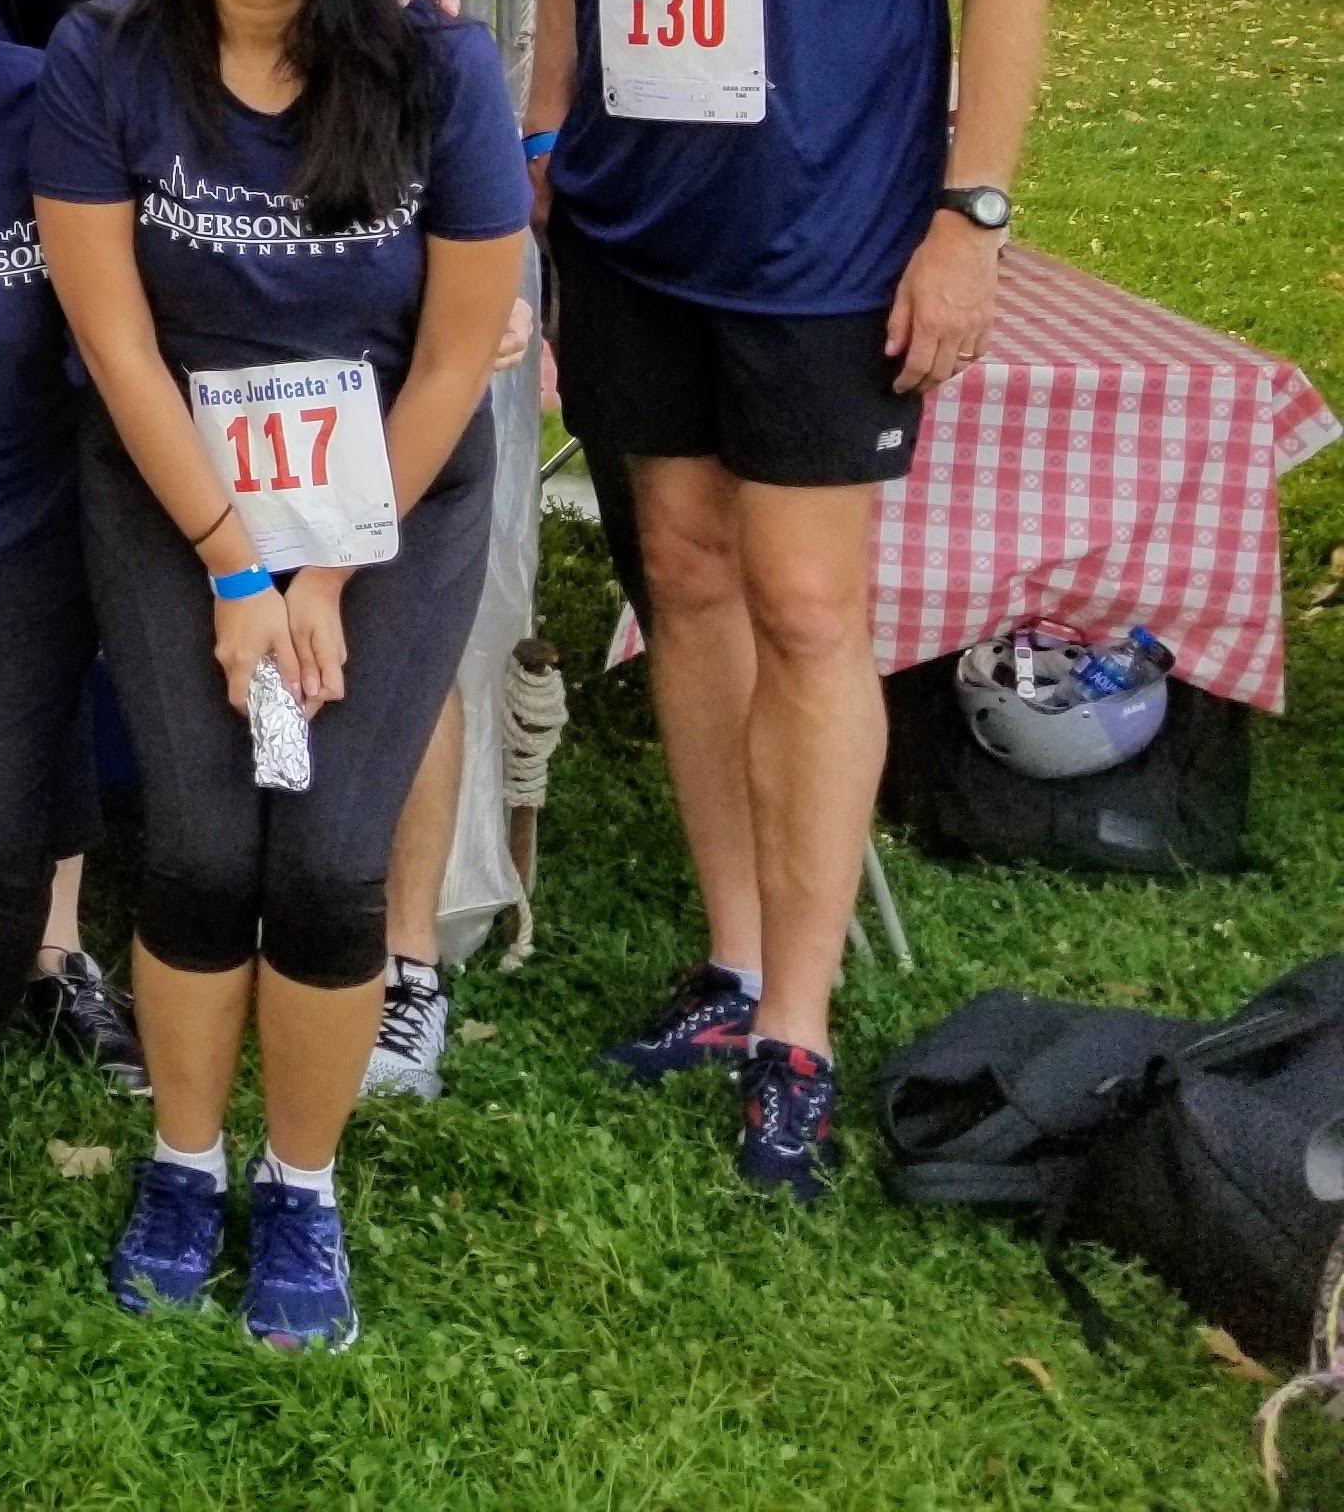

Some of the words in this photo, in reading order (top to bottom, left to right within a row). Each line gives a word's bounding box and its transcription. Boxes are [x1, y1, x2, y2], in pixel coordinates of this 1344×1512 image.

[144, 192, 302, 239] ANDERSON
[171, 230, 345, 256] PARTNERS
[198, 384, 242, 406] Race
[337, 370, 362, 392] 19
[227, 406, 338, 492] 117
